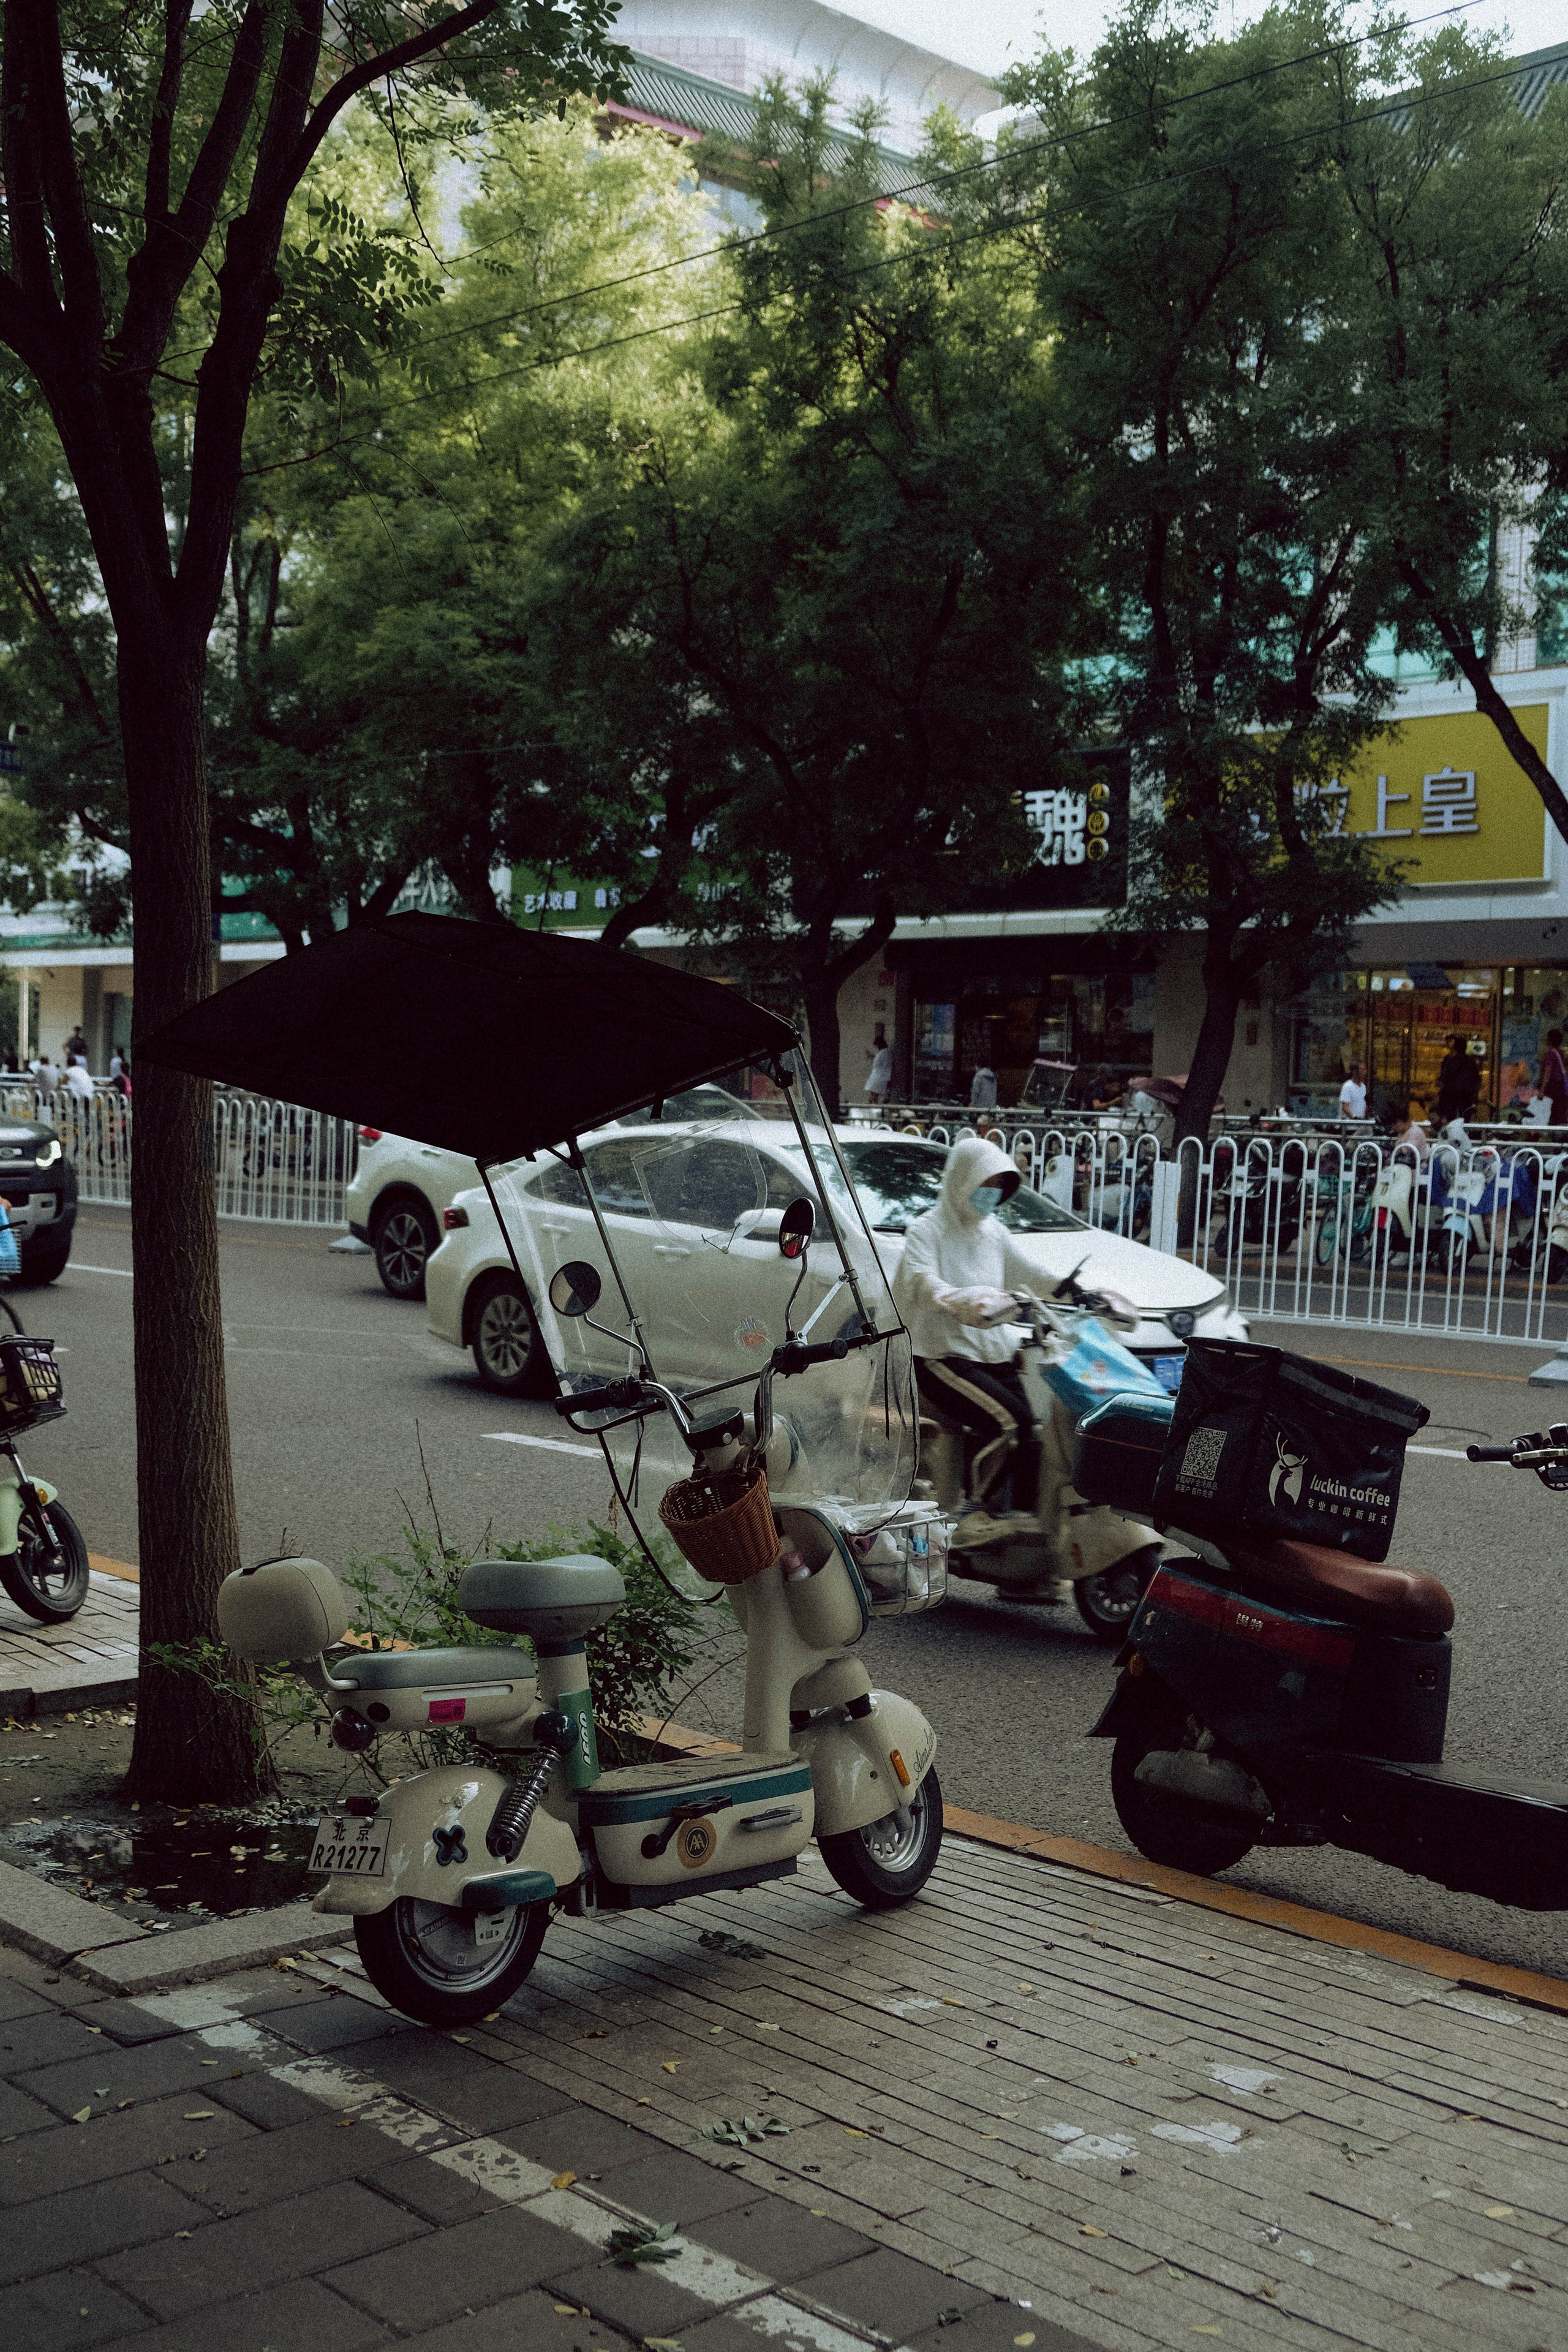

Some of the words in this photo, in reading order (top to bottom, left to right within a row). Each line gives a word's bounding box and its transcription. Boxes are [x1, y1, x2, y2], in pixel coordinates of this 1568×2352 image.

[1310, 1474, 1347, 1498] luckin
[1350, 1487, 1390, 1507] coffee
[333, 1824, 371, 1841] 北京
[313, 1844, 380, 1871] R21277
